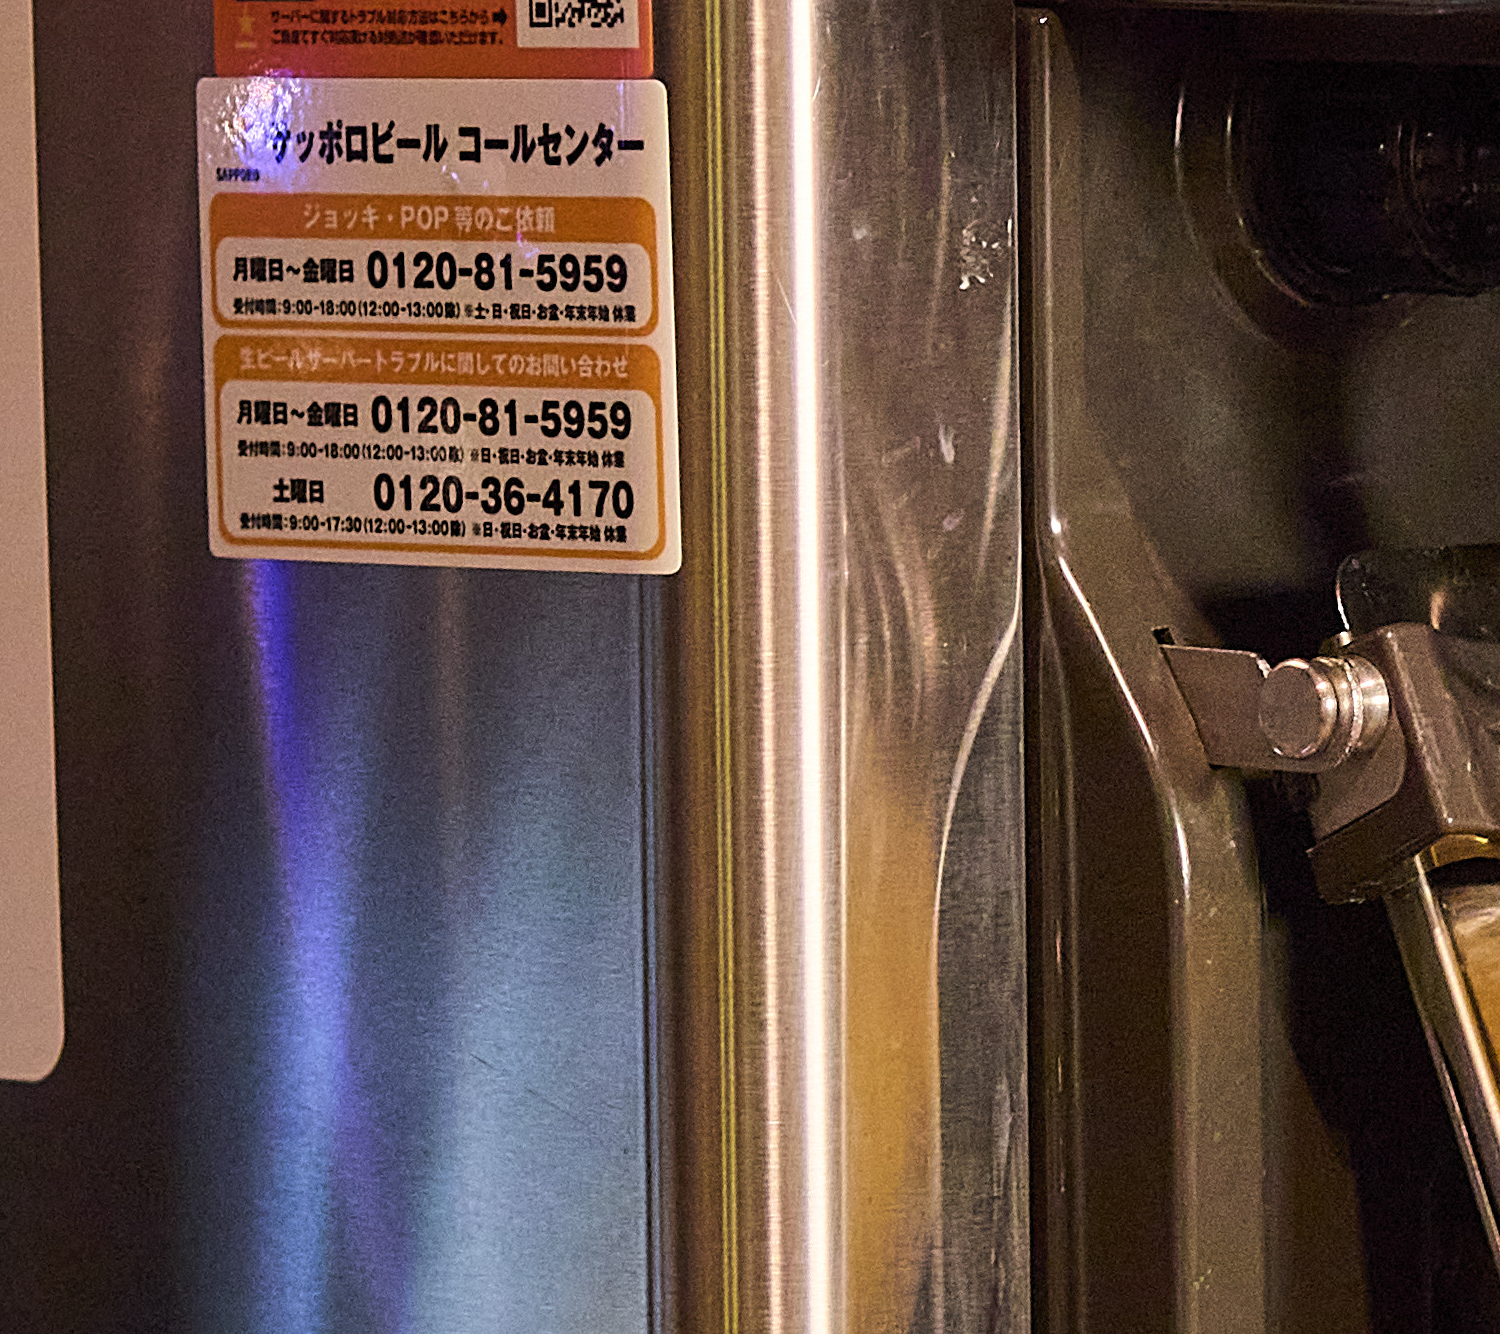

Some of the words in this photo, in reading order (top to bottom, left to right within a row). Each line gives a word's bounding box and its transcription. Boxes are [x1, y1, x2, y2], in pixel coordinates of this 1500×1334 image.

[458, 121, 645, 168] コールセンター
[367, 249, 629, 294] 0120-81-5959
[371, 395, 632, 440] 0120-81-5959
[272, 478, 325, 505] 土曜日
[373, 473, 635, 520] 0120-36-4170
